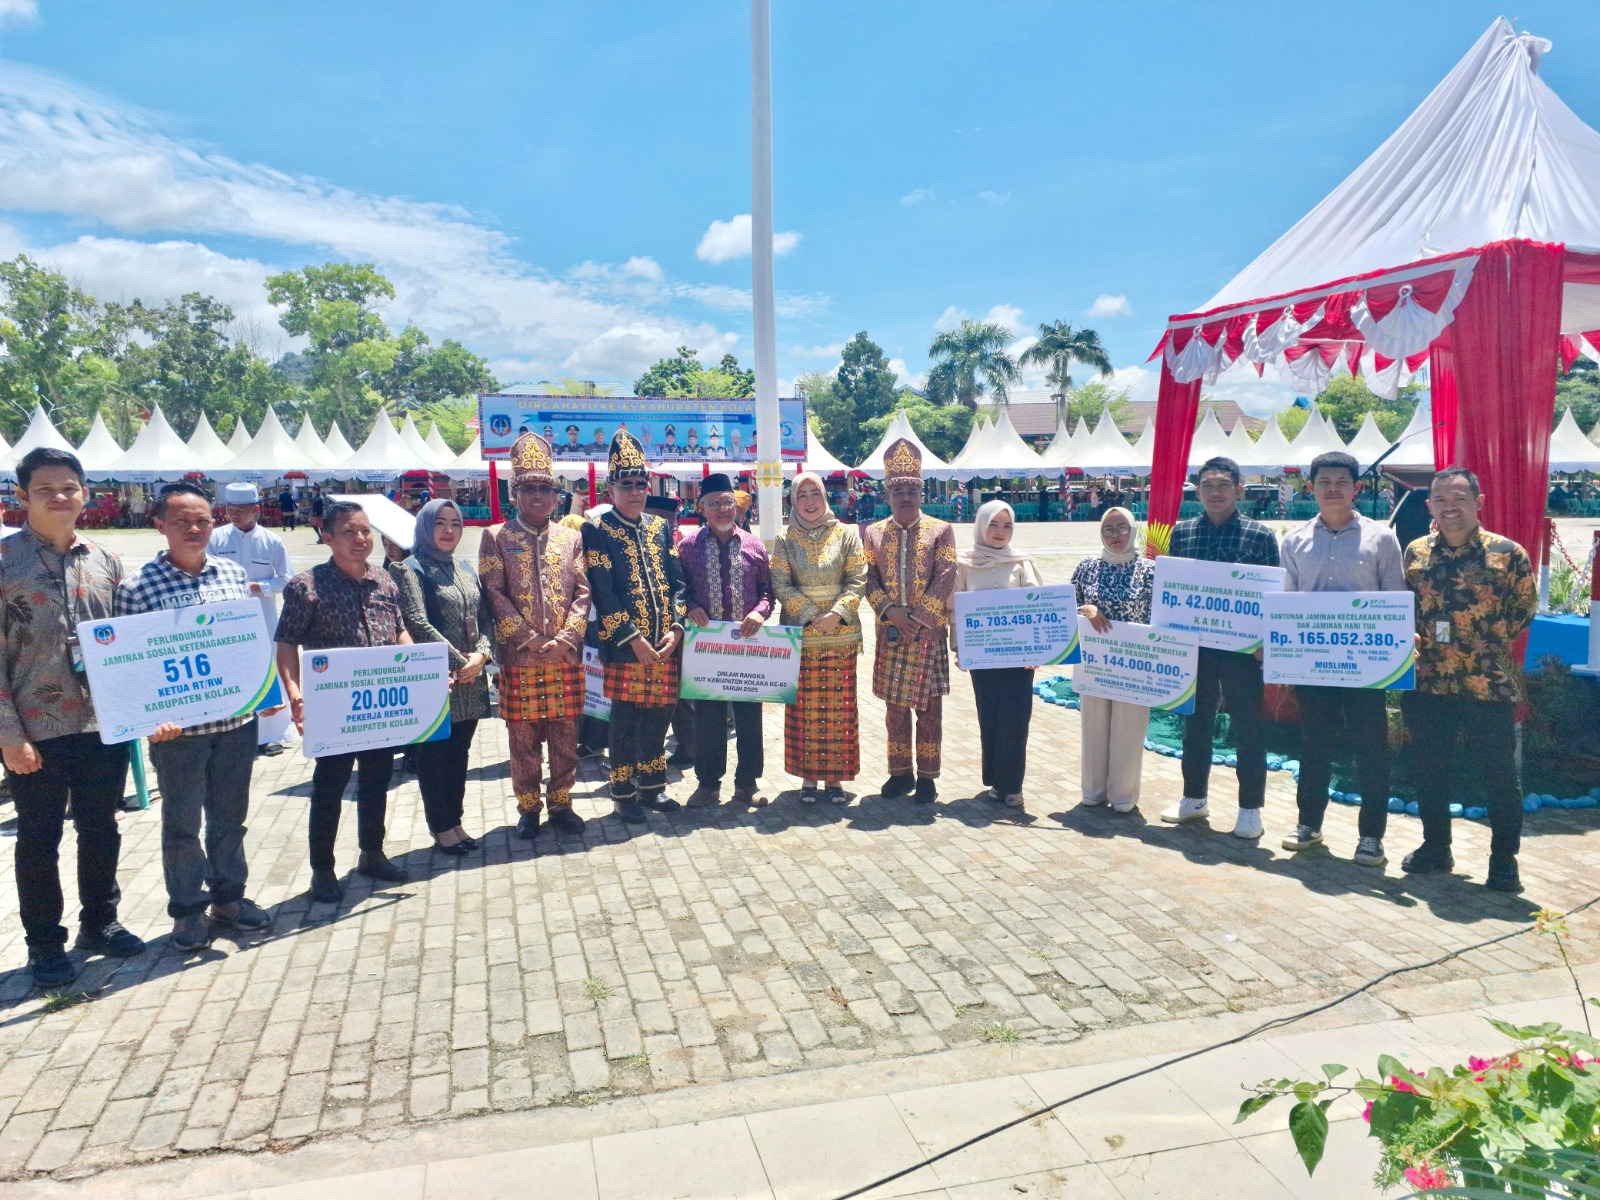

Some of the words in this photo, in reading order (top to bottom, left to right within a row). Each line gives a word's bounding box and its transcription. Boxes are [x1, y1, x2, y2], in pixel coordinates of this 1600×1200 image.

[518, 399, 597, 412] DIRGAHAYU
[600, 401, 637, 412] KE-65
[640, 402, 715, 413] KABUPATEN
[1164, 582, 1199, 591] SANTUNAN
[1201, 586, 1233, 596] JAMINAN
[1235, 590, 1264, 599] KEMATI
[1162, 591, 1181, 609] Rp.
[966, 618, 984, 630] Rp.
[987, 613, 1067, 627] 703.458.740,-
[148, 629, 213, 646] PERLINDUNGAN
[1210, 628, 1238, 637] KABUPATEN
[1271, 631, 1292, 646] Rp.
[1299, 632, 1406, 649] 165.052.380,-
[103, 652, 144, 667] JAMINAN
[147, 646, 177, 659] SOSIAL
[179, 632, 257, 652] KETENAGAKERJAAN
[694, 642, 723, 654] BANTUAN
[723, 643, 746, 656] RUMAH
[746, 645, 770, 658] TAHFIDZ
[1084, 636, 1119, 647] SANTUNAN
[1120, 641, 1151, 651] JAMINAN
[1152, 646, 1187, 657] KEMATIAN
[1125, 649, 1159, 660] BEASISWA
[163, 653, 211, 683] 516
[353, 667, 406, 677] PERLINDUNGAN
[1082, 651, 1098, 666] Rp.
[1103, 655, 1190, 679] 144.000.000,-
[1315, 662, 1357, 670] MUSLIMIN
[158, 684, 190, 697] KETUA
[193, 677, 223, 691] RT/RW
[315, 682, 349, 691] JAMINAN
[351, 678, 375, 687] SOSIAL
[377, 673, 440, 685] KETENAGAKERJAAN
[1095, 677, 1124, 687] MUHAMAD
[1142, 685, 1171, 695] GUNAWAN
[144, 694, 202, 713] KABUPATEN
[205, 685, 241, 701] KOLAKA
[352, 686, 409, 711] 20.000
[346, 712, 382, 723] PEKERJA
[384, 708, 414, 719] RENTAN
[341, 722, 387, 734] KABUPATEN
[390, 718, 419, 729] KOLAKA
